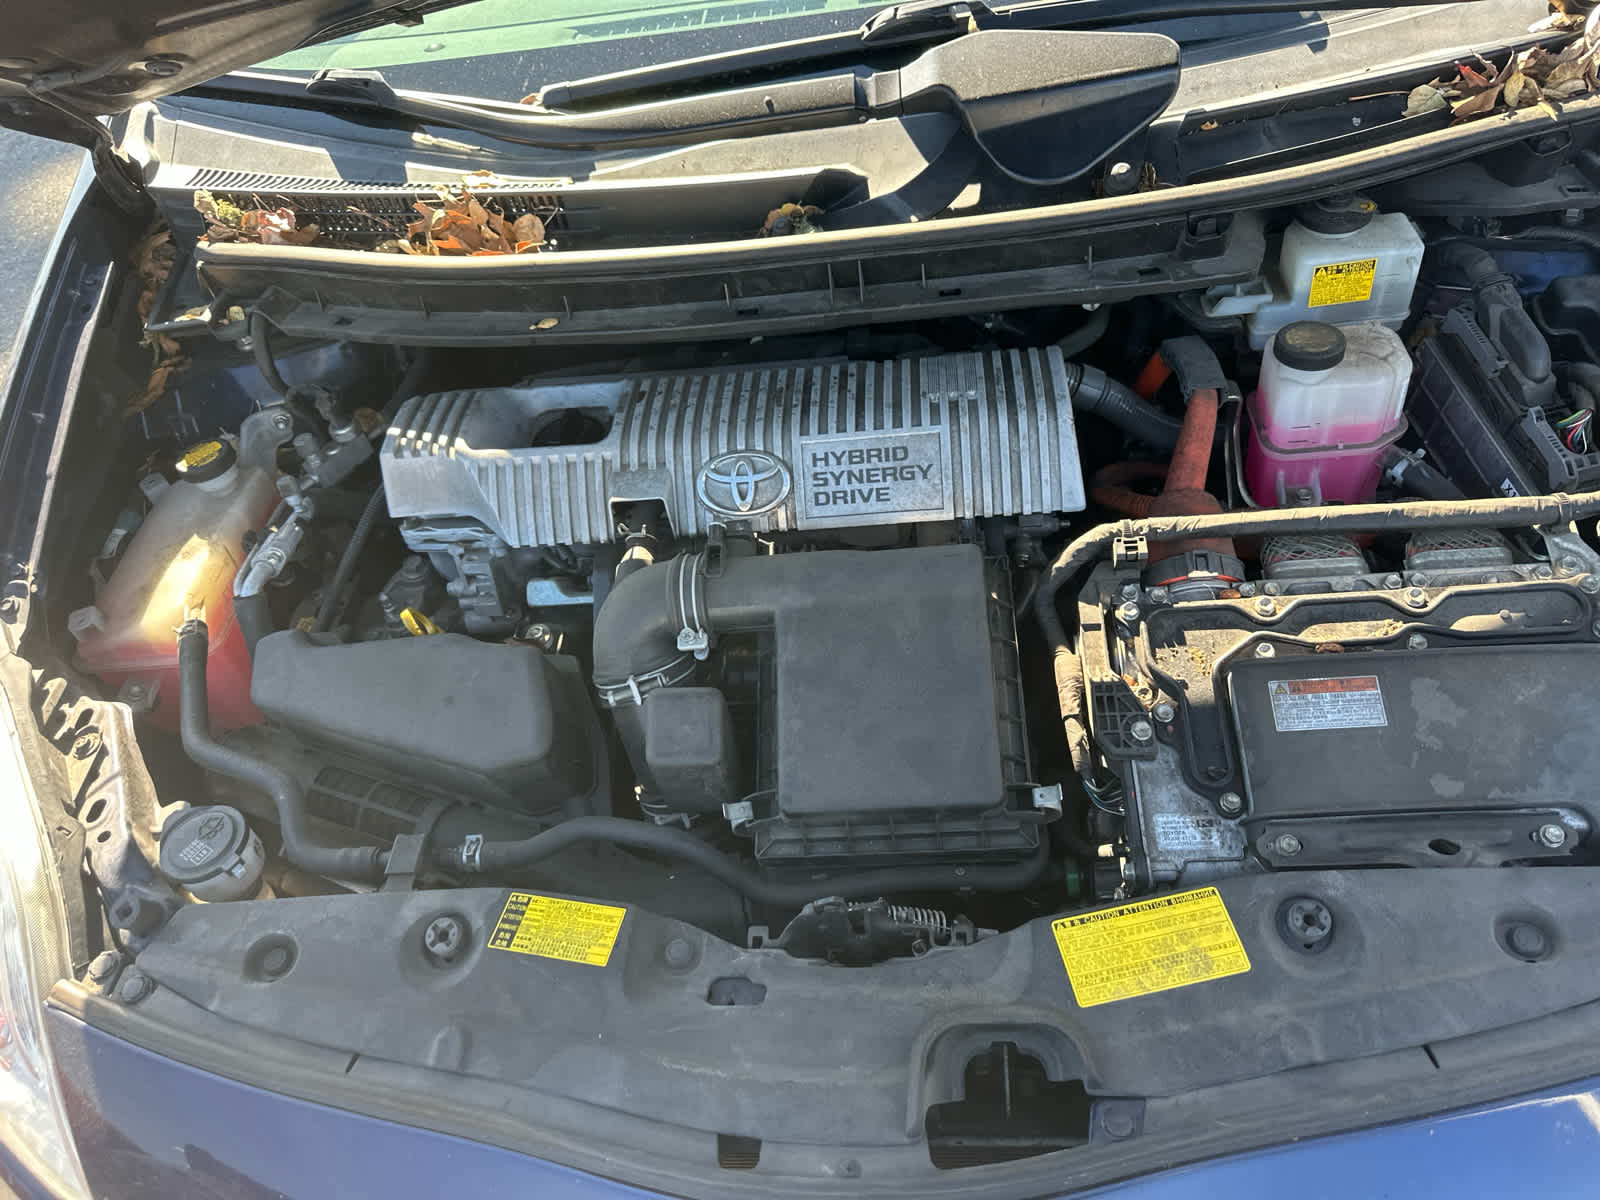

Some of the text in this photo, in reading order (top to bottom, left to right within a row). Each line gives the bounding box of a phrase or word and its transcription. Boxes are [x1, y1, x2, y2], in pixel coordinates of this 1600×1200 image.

[812, 446, 908, 467] HYBRID
[812, 464, 933, 487] SYNERGY
[814, 487, 890, 506] DRIVE
[1085, 910, 1119, 923] CAUTION
[1124, 900, 1167, 915] ATTENTION
[1172, 889, 1216, 905] ВНИМАНИЕ
